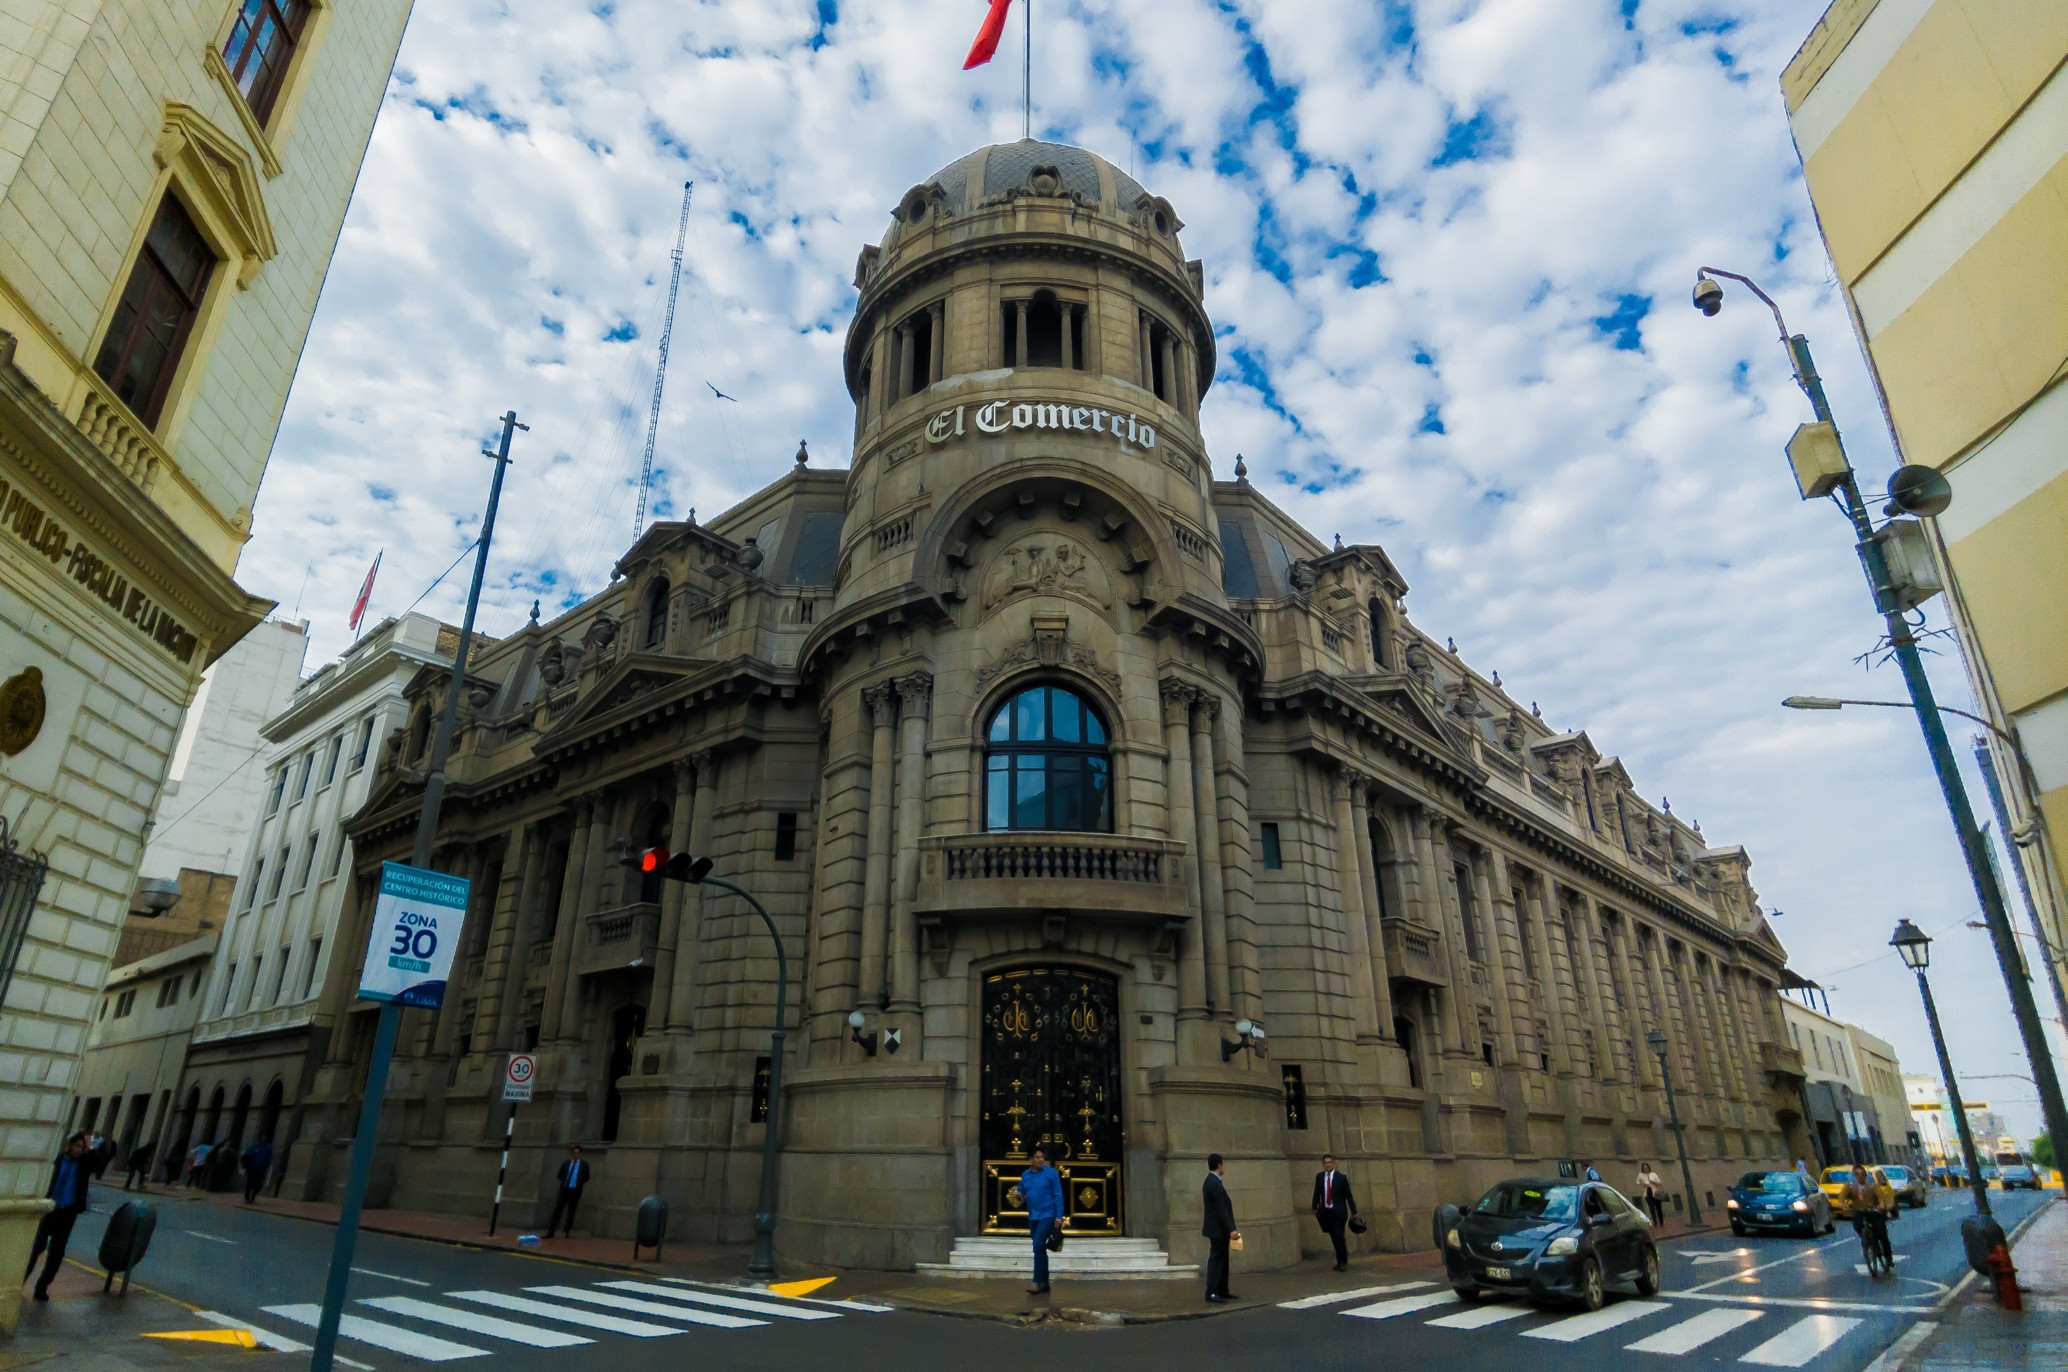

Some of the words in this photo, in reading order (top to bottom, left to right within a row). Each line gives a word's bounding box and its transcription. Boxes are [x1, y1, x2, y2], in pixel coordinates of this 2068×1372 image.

[923, 405, 967, 444] El
[975, 400, 1156, 449] Comercio
[384, 882, 418, 896] CENTRO
[419, 889, 465, 905] HISTÓRICO
[385, 870, 450, 891] RECUPERACIÓN
[451, 884, 466, 895] DEL
[399, 911, 438, 930] ZONA
[390, 924, 438, 959] 30
[397, 957, 422, 970] km/h
[513, 1063, 530, 1074] 30
